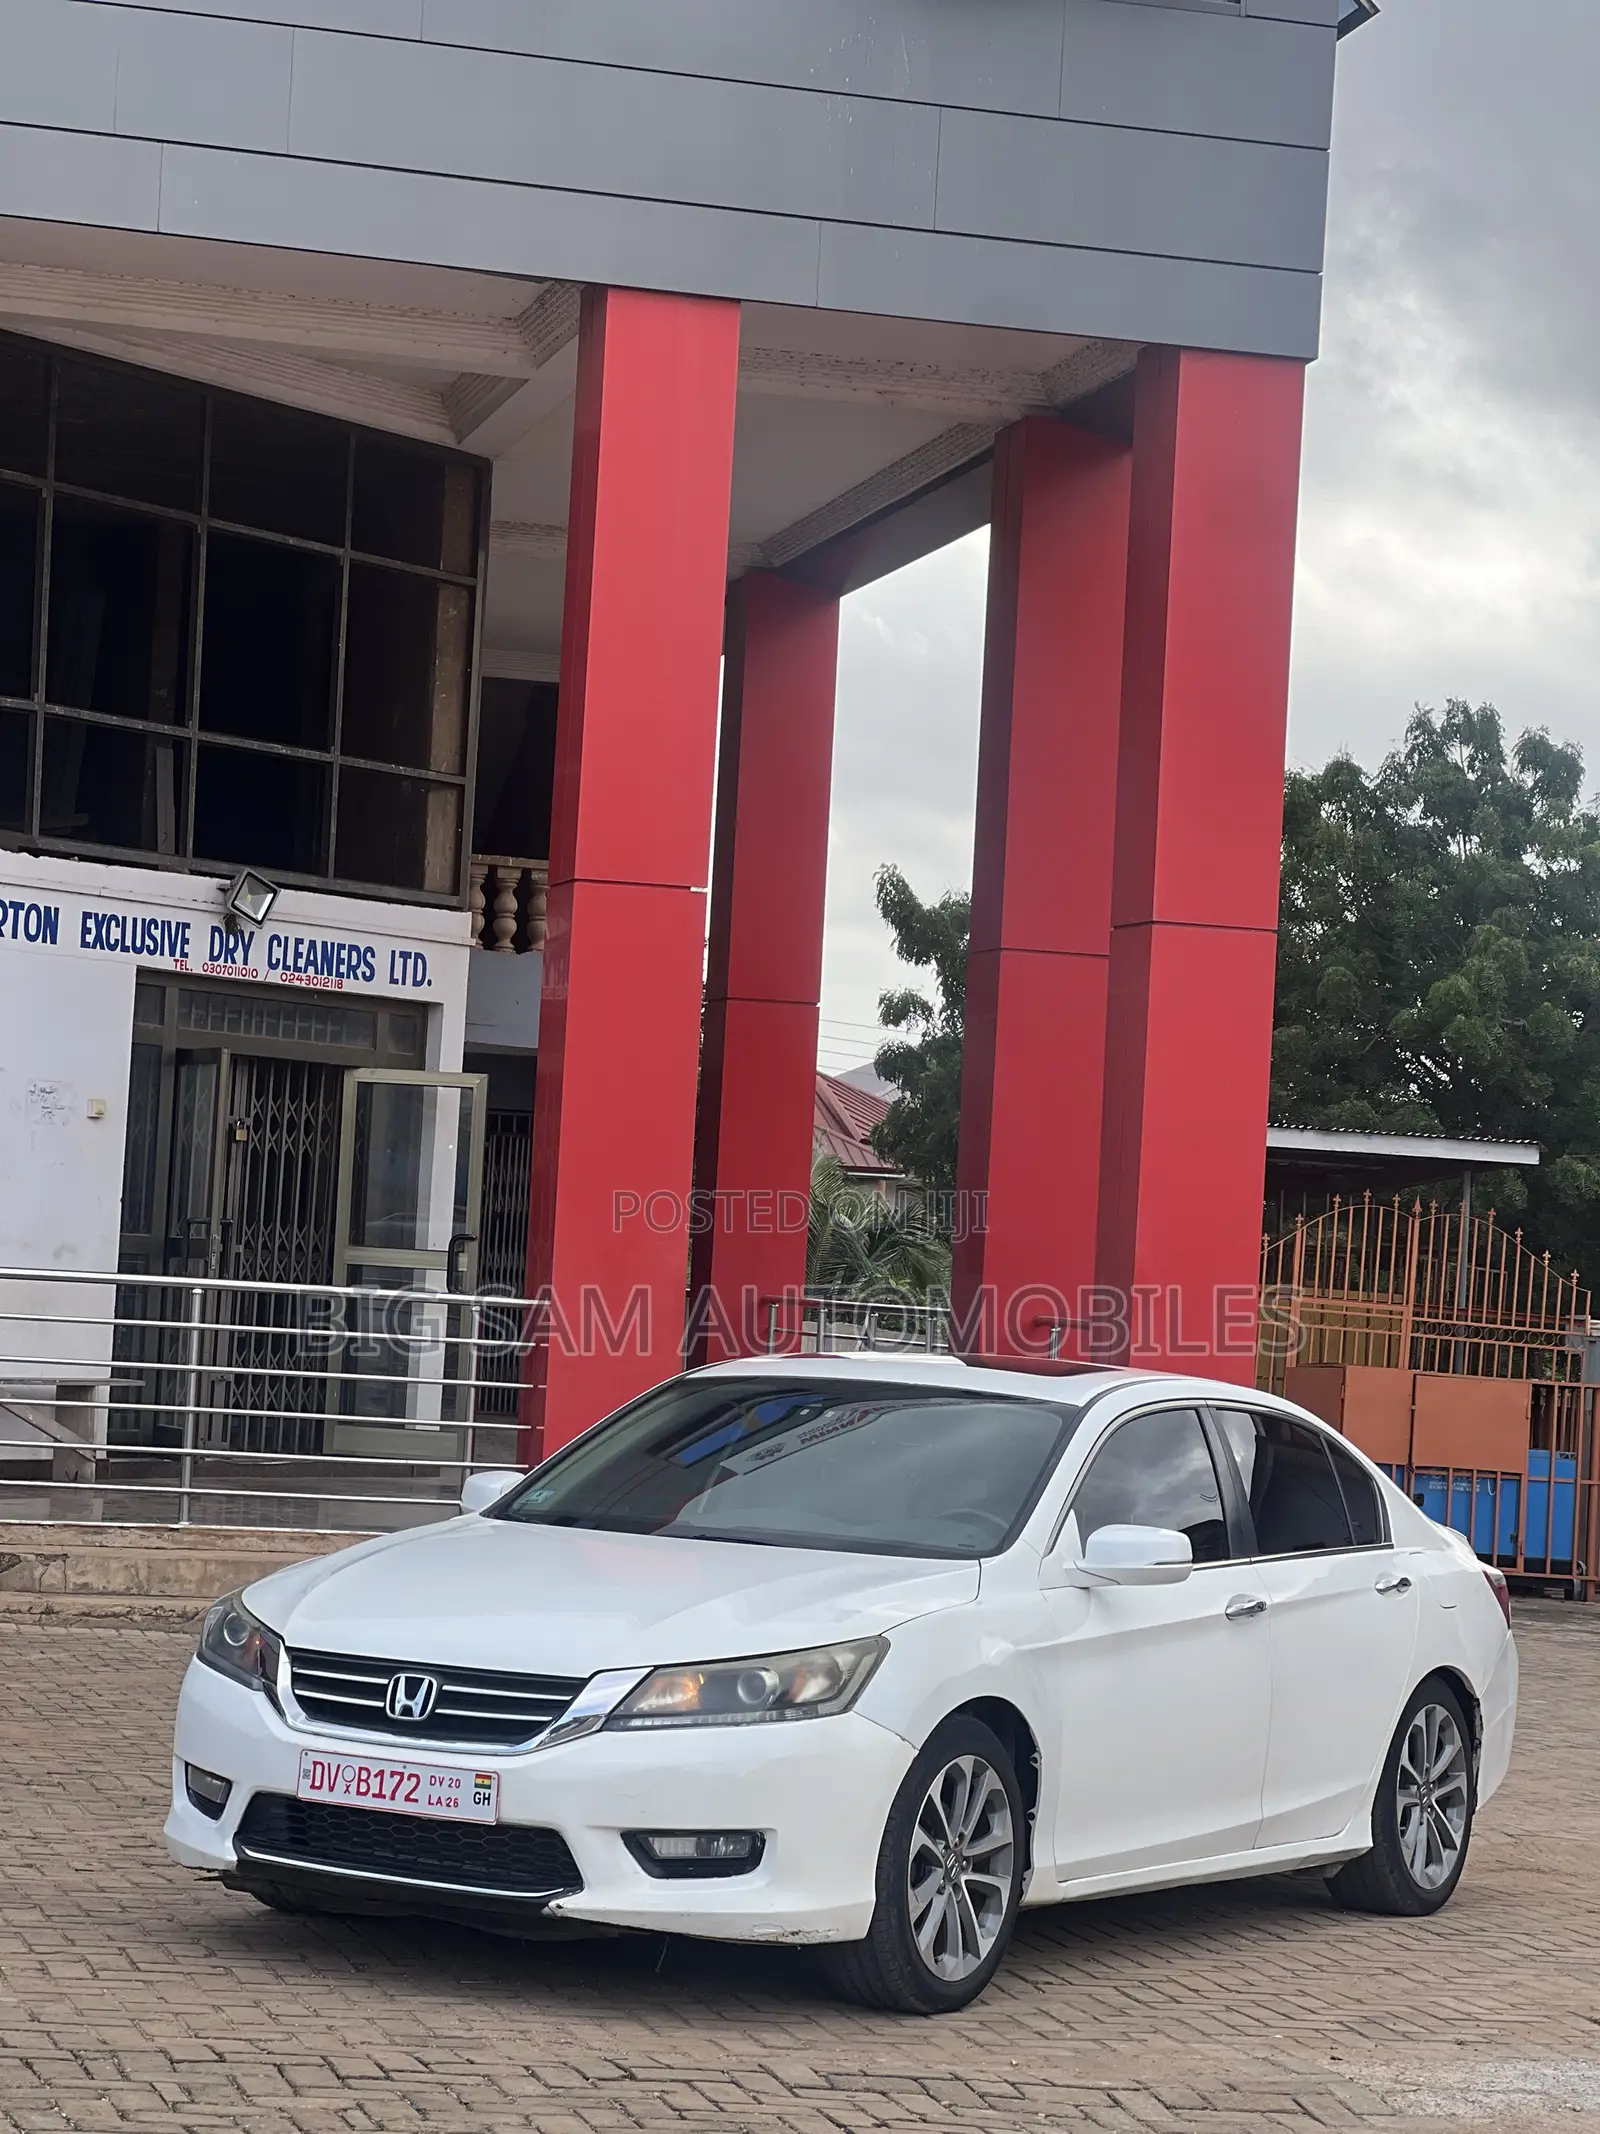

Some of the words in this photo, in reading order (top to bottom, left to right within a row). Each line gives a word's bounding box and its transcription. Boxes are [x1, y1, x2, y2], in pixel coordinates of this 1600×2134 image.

[80, 911, 191, 958] EXCLUSIVE
[209, 926, 254, 965] DRY
[267, 934, 375, 982] CLEANERS
[389, 950, 432, 987] LTD.
[173, 959, 193, 972] TEL.
[280, 972, 343, 989] 0243012118
[429, 1775, 445, 1787] DV
[427, 1794, 443, 1806] LA
[473, 1791, 491, 1807] GH
